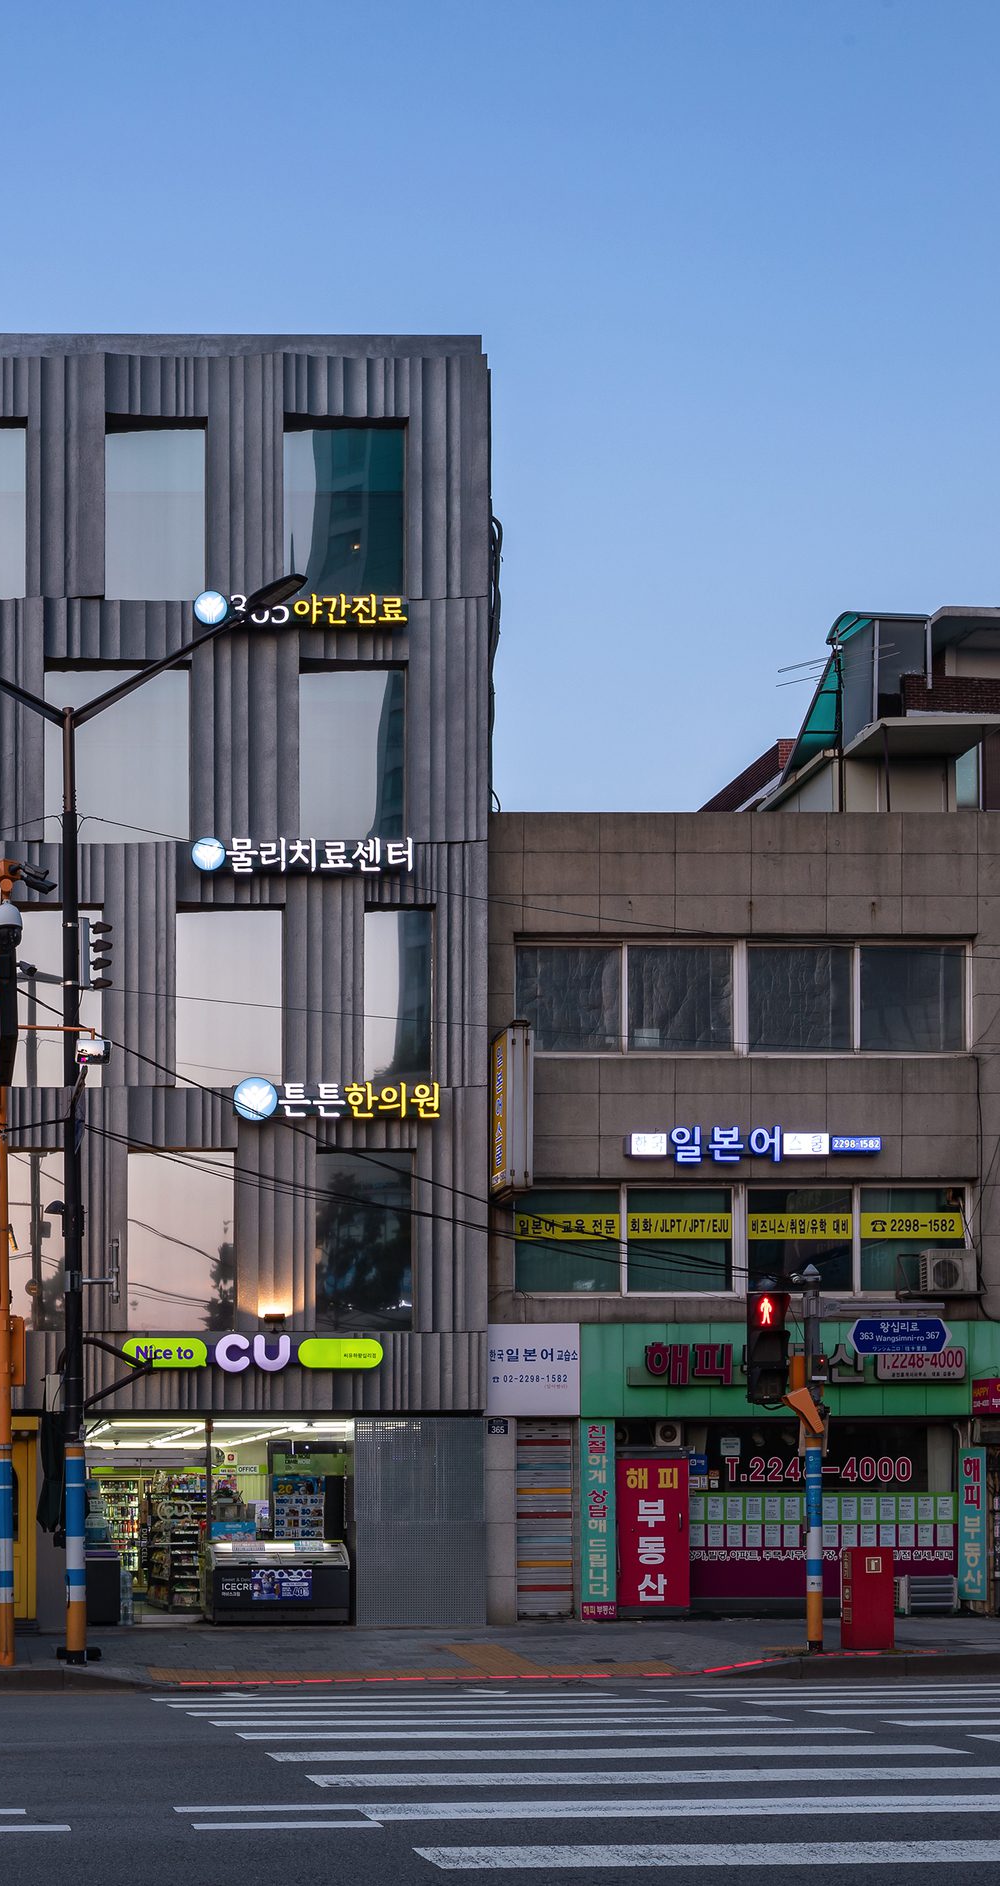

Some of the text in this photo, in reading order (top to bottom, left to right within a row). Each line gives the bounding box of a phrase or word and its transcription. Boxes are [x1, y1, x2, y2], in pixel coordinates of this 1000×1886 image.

[225, 837, 414, 874] 물리치료센터
[277, 1081, 441, 1120] 튼튼한의원
[670, 1125, 782, 1164] 일본어
[833, 1138, 881, 1150] 2298-1582
[519, 1218, 616, 1235] 일본어 교육 전문
[832, 1218, 849, 1235] 대비
[890, 1218, 955, 1233] 2298-1582
[859, 1331, 940, 1344] 363 Wangsimni-ro 367
[879, 1321, 920, 1333] 왕십리로
[135, 1333, 291, 1372] Nice to CU
[644, 1341, 734, 1386] 해피
[503, 1374, 568, 1383] 02-2298-1582
[491, 1425, 505, 1434] 365
[587, 1425, 608, 1484] 친절하게
[725, 1456, 913, 1483] T.224-4000
[625, 1467, 680, 1602] 해피 부동산
[963, 1457, 983, 1594] 해피 부동산
[588, 1539, 610, 1598] 드립니다
[583, 1605, 615, 1615] 해피 부동산
